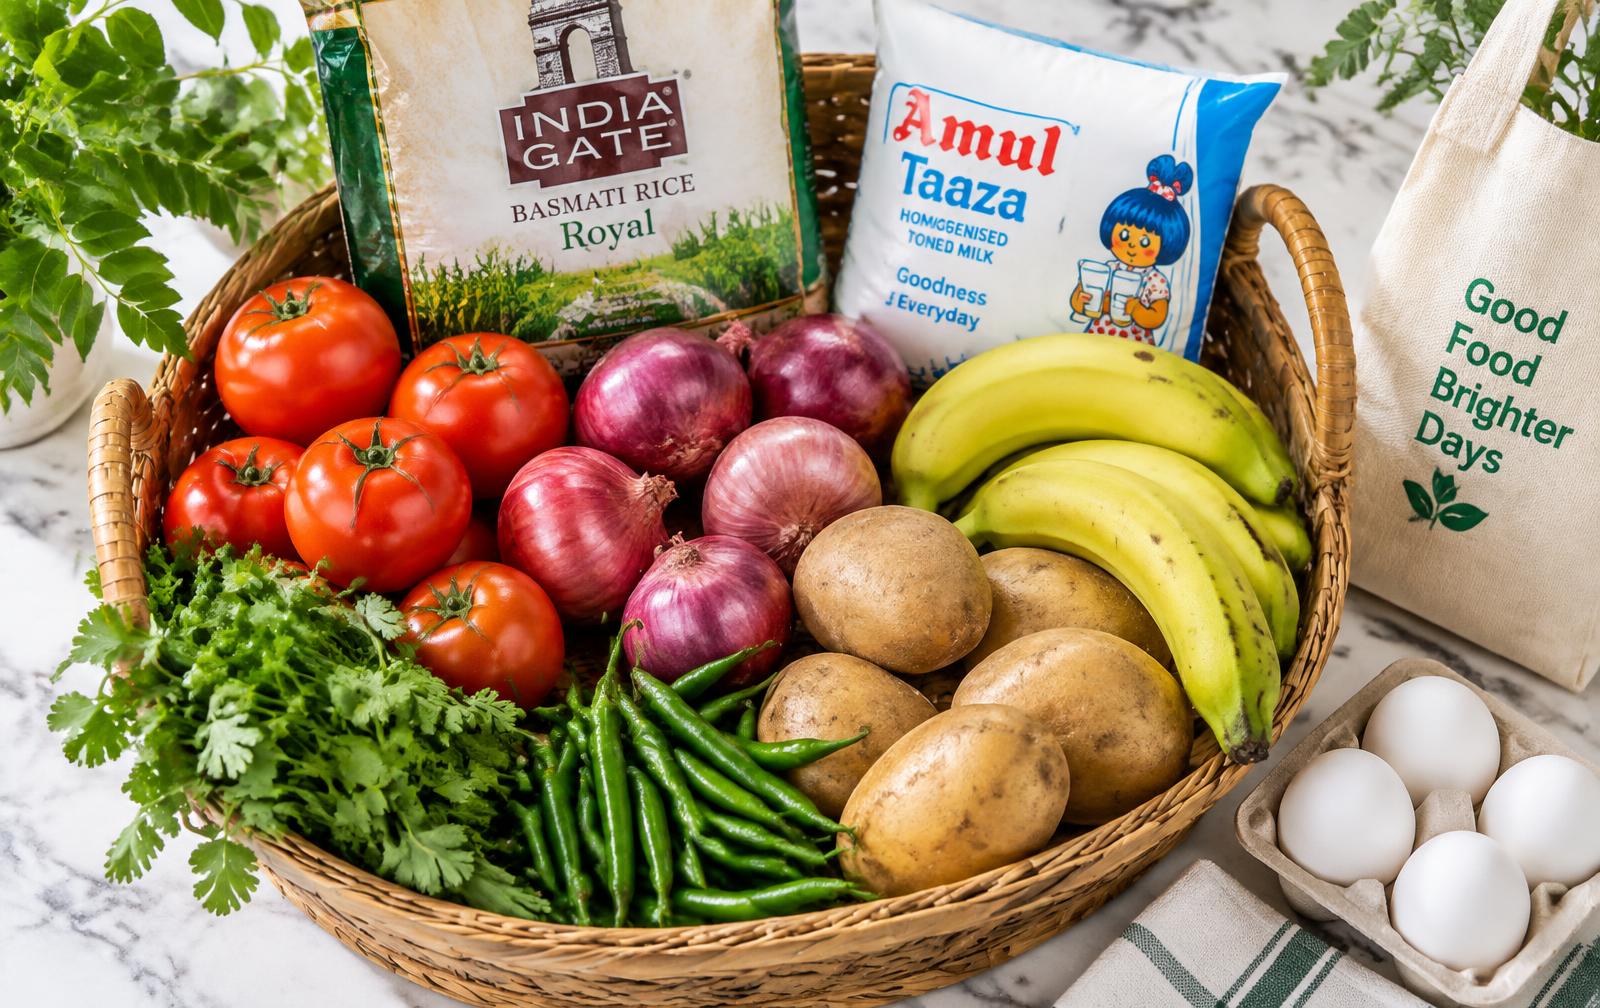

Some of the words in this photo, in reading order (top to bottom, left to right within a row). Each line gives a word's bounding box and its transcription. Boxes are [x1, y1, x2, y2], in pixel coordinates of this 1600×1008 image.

[513, 91, 673, 141] INDIA
[893, 88, 1061, 176] Amul
[523, 122, 672, 170] GATE
[511, 187, 627, 223] BASMATI
[634, 173, 696, 201] RICE
[901, 151, 1027, 222] Taaza
[560, 208, 656, 251] Royal
[908, 229, 955, 254] TONED
[957, 244, 994, 264] MILK
[896, 266, 988, 306] Goodness
[1464, 277, 1568, 344] Good
[897, 294, 980, 332] Everyday
[1445, 320, 1543, 387] Food
[1430, 366, 1574, 449] Brighter
[1414, 409, 1503, 473] Days
